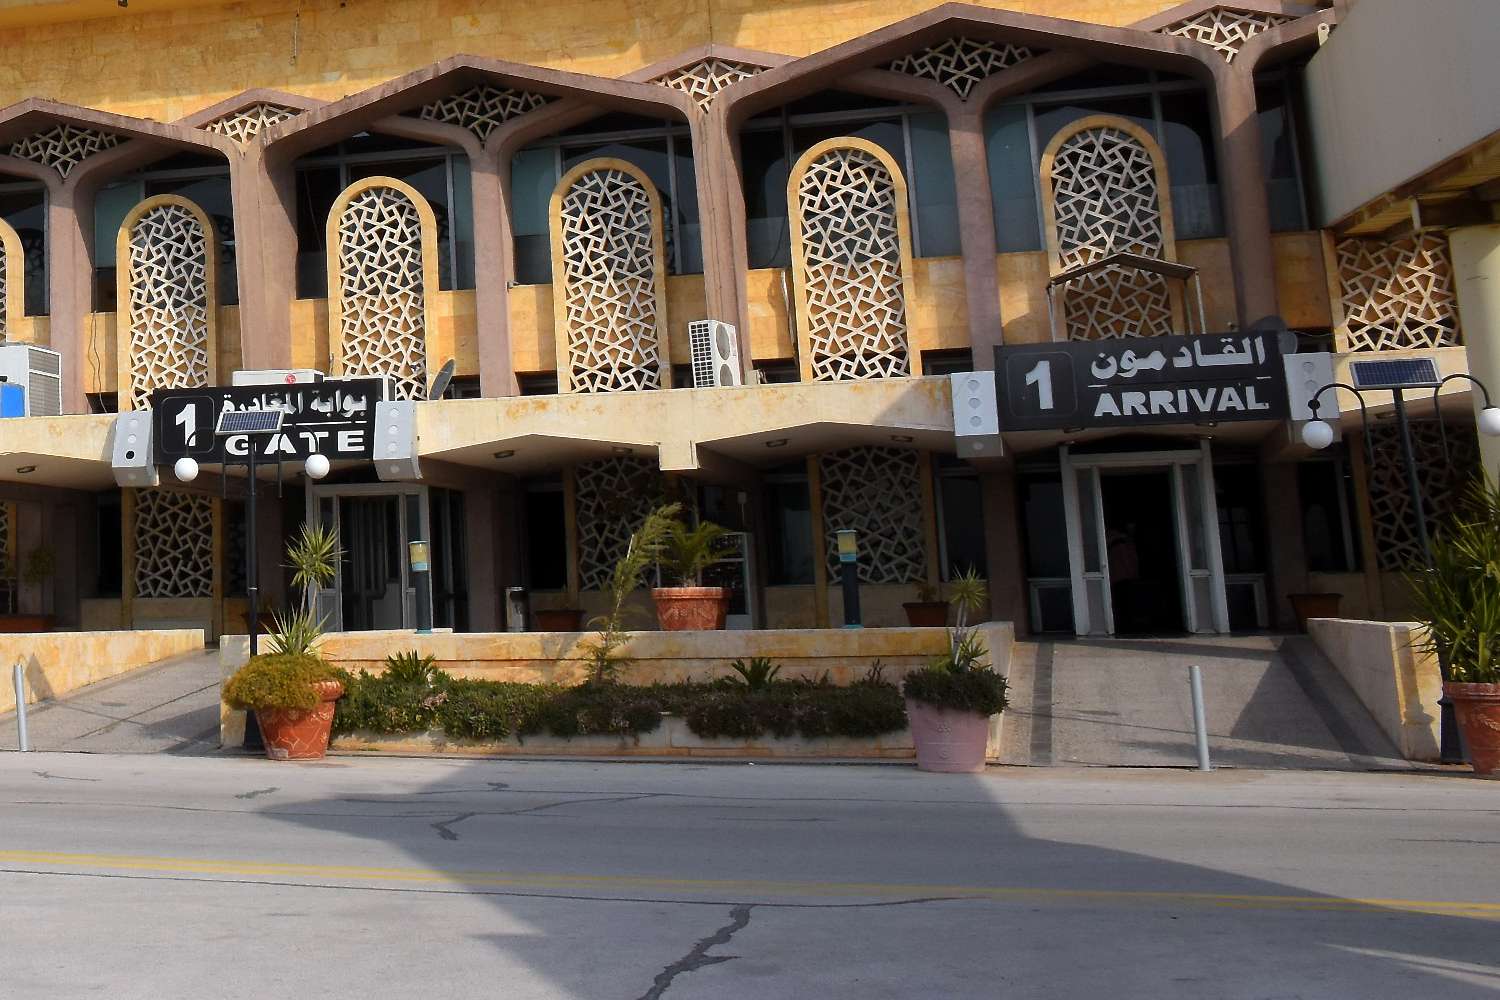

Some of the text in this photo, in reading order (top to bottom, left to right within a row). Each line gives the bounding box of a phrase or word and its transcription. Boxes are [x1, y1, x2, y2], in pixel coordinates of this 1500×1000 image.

[1091, 335, 1266, 380] القادمون
[310, 389, 367, 417] بوابة
[1025, 360, 1054, 410] 1
[1094, 386, 1269, 417] ARRIVAL
[175, 403, 196, 447] 1
[225, 430, 365, 456] GATE
